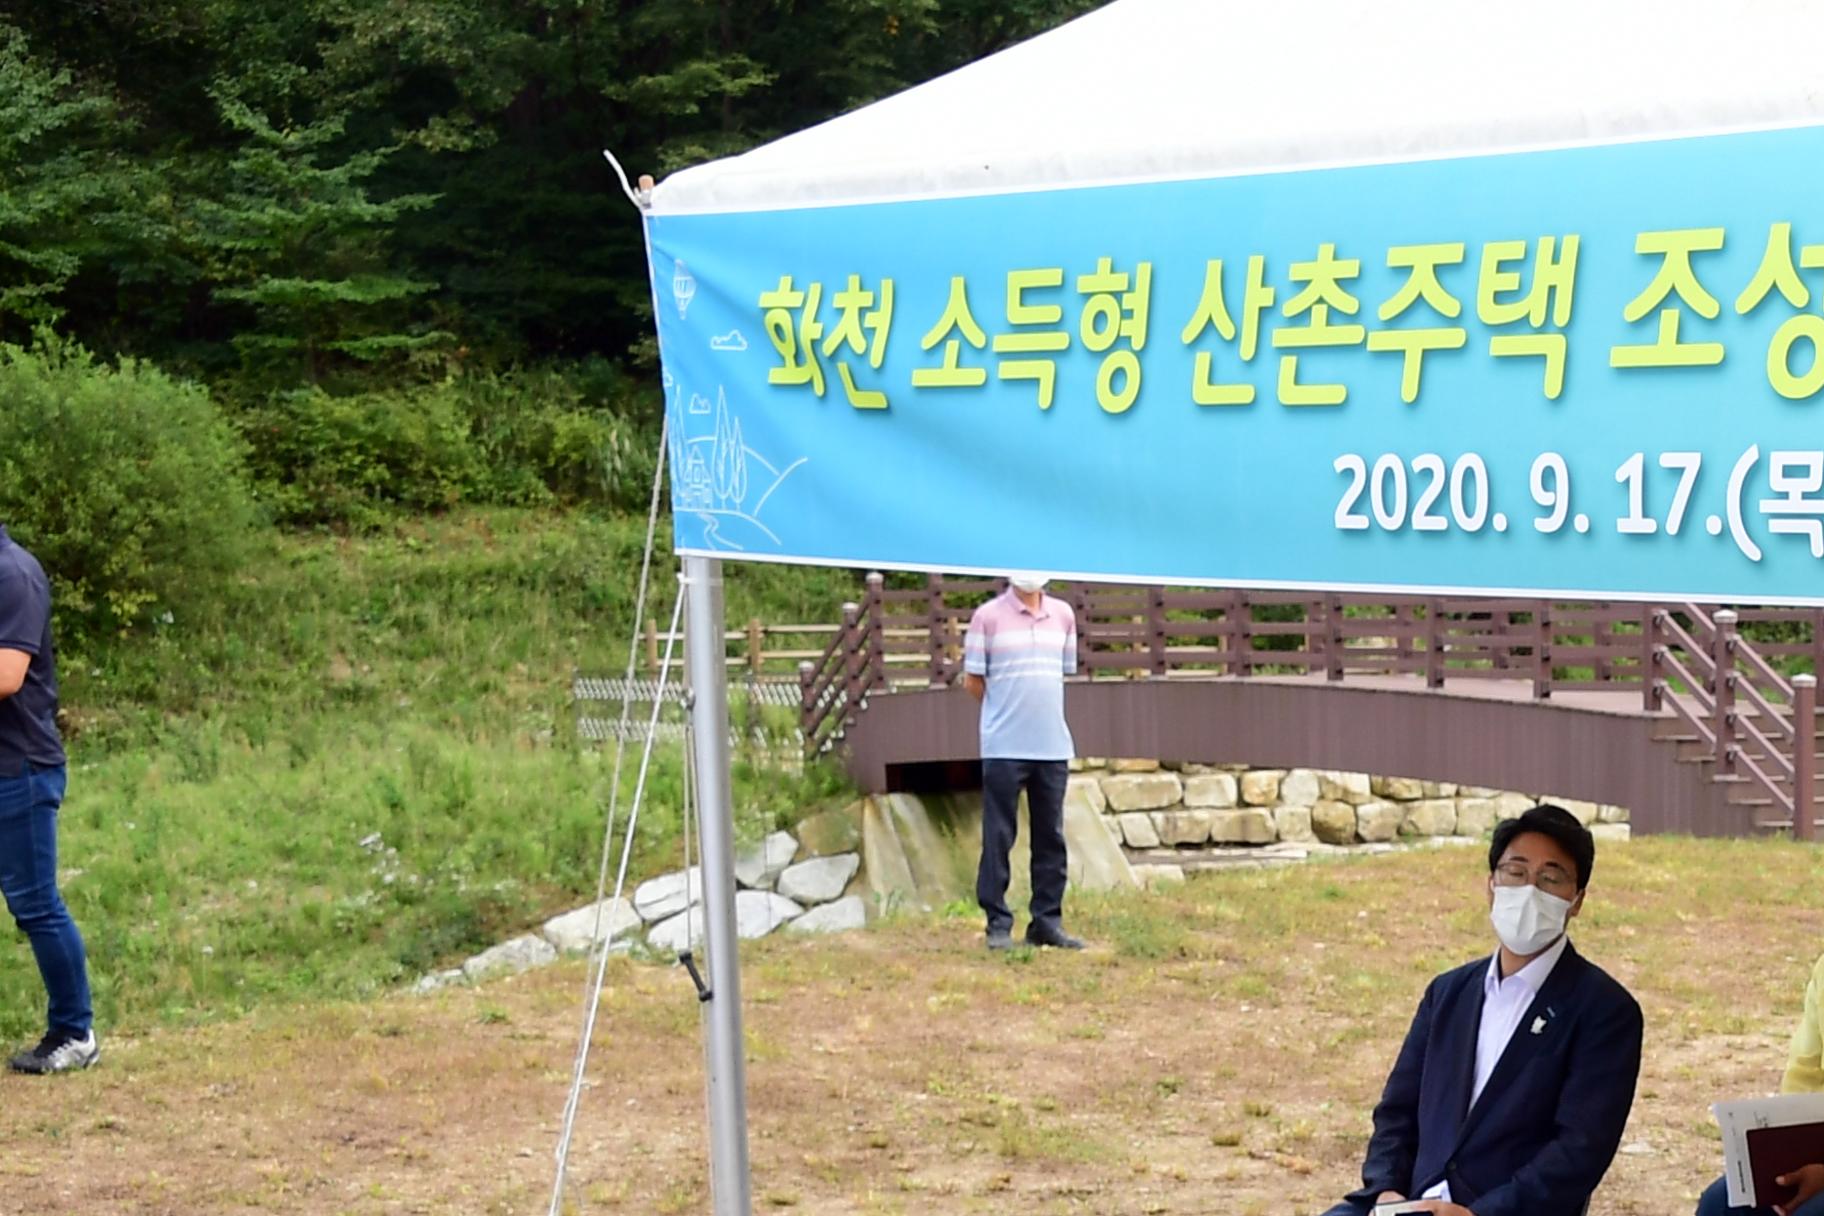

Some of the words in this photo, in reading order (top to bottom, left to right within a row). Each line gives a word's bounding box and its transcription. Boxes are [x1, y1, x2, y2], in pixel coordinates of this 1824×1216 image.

[758, 276, 893, 409] 화천
[912, 257, 1153, 415] 소득형
[1182, 234, 1580, 407] 산촌주택
[1333, 453, 1508, 533] 2020.
[1530, 452, 1590, 534] 9.
